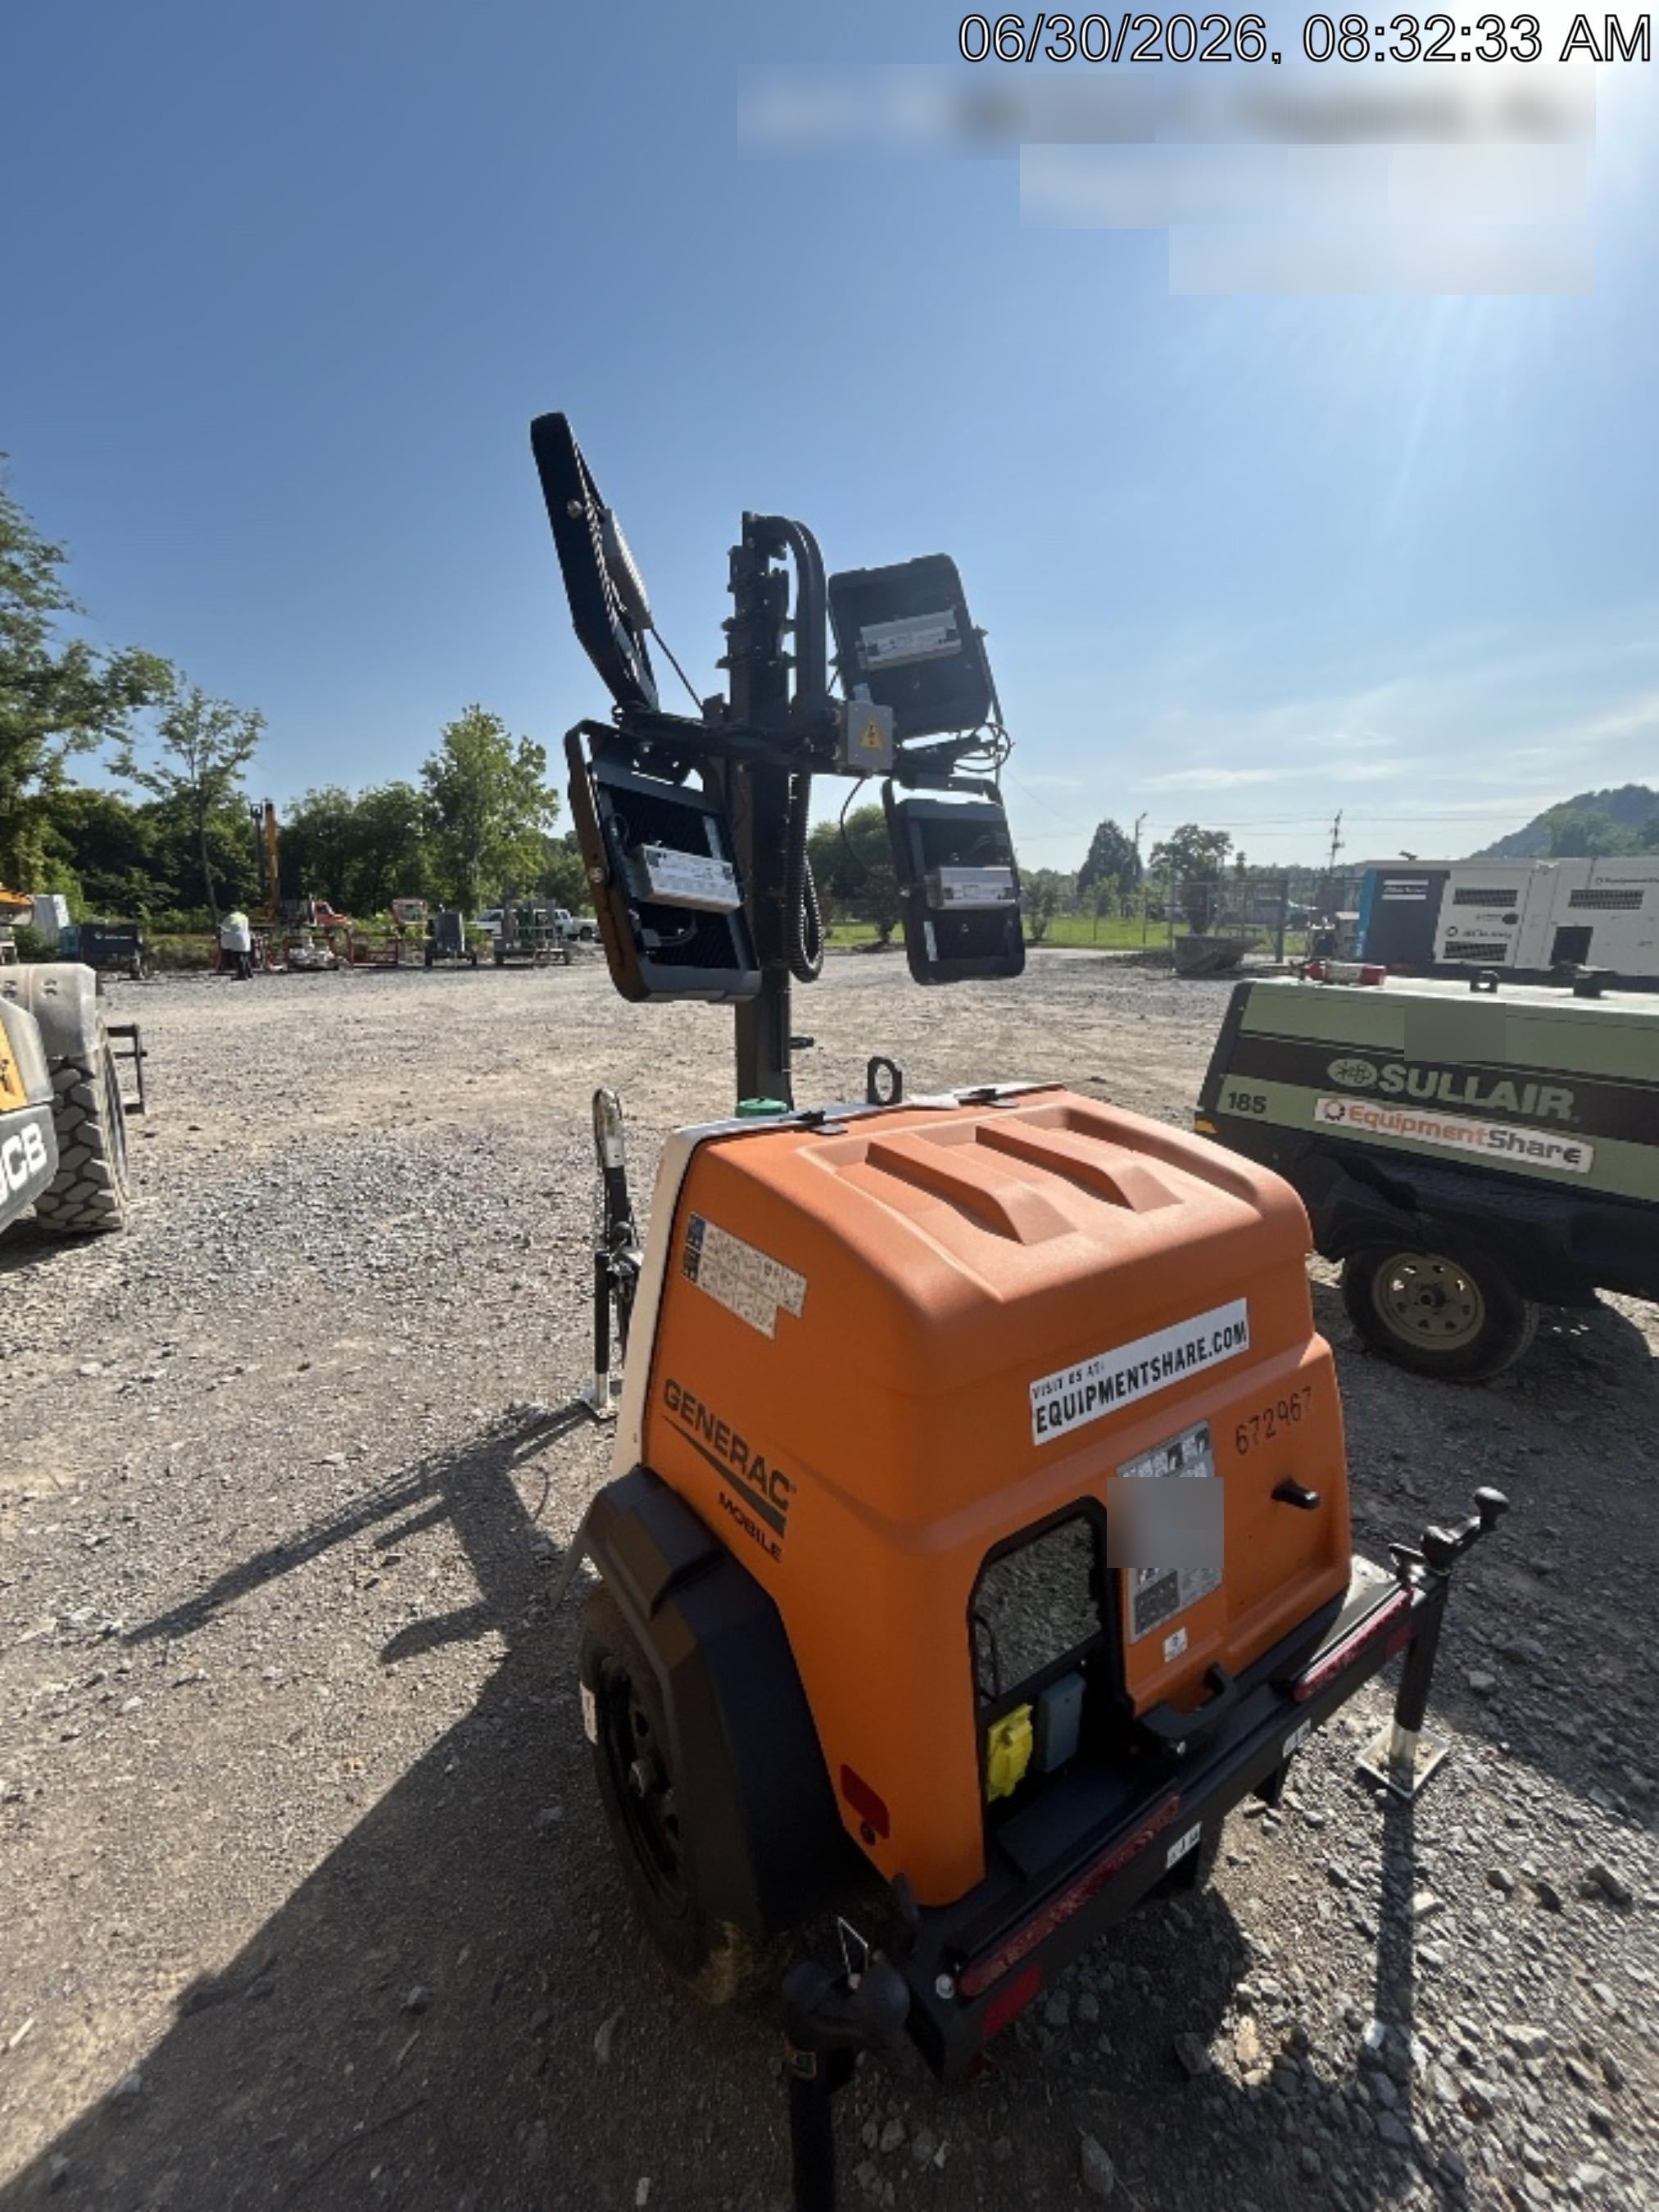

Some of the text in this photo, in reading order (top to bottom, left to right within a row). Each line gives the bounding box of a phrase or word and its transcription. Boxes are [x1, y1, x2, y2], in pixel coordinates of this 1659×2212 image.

[1229, 1091, 1267, 1115] 185
[1379, 1063, 1574, 1122] SULLAIR
[1348, 1104, 1581, 1165] EquipmentShare
[1031, 1376, 1063, 1399] VISIT
[1036, 1319, 1247, 1434] EQUIPMENTSHARE.COM
[664, 1378, 791, 1512] GENERAC
[1235, 1385, 1311, 1456] 672967
[718, 1491, 782, 1564] MOBILE
